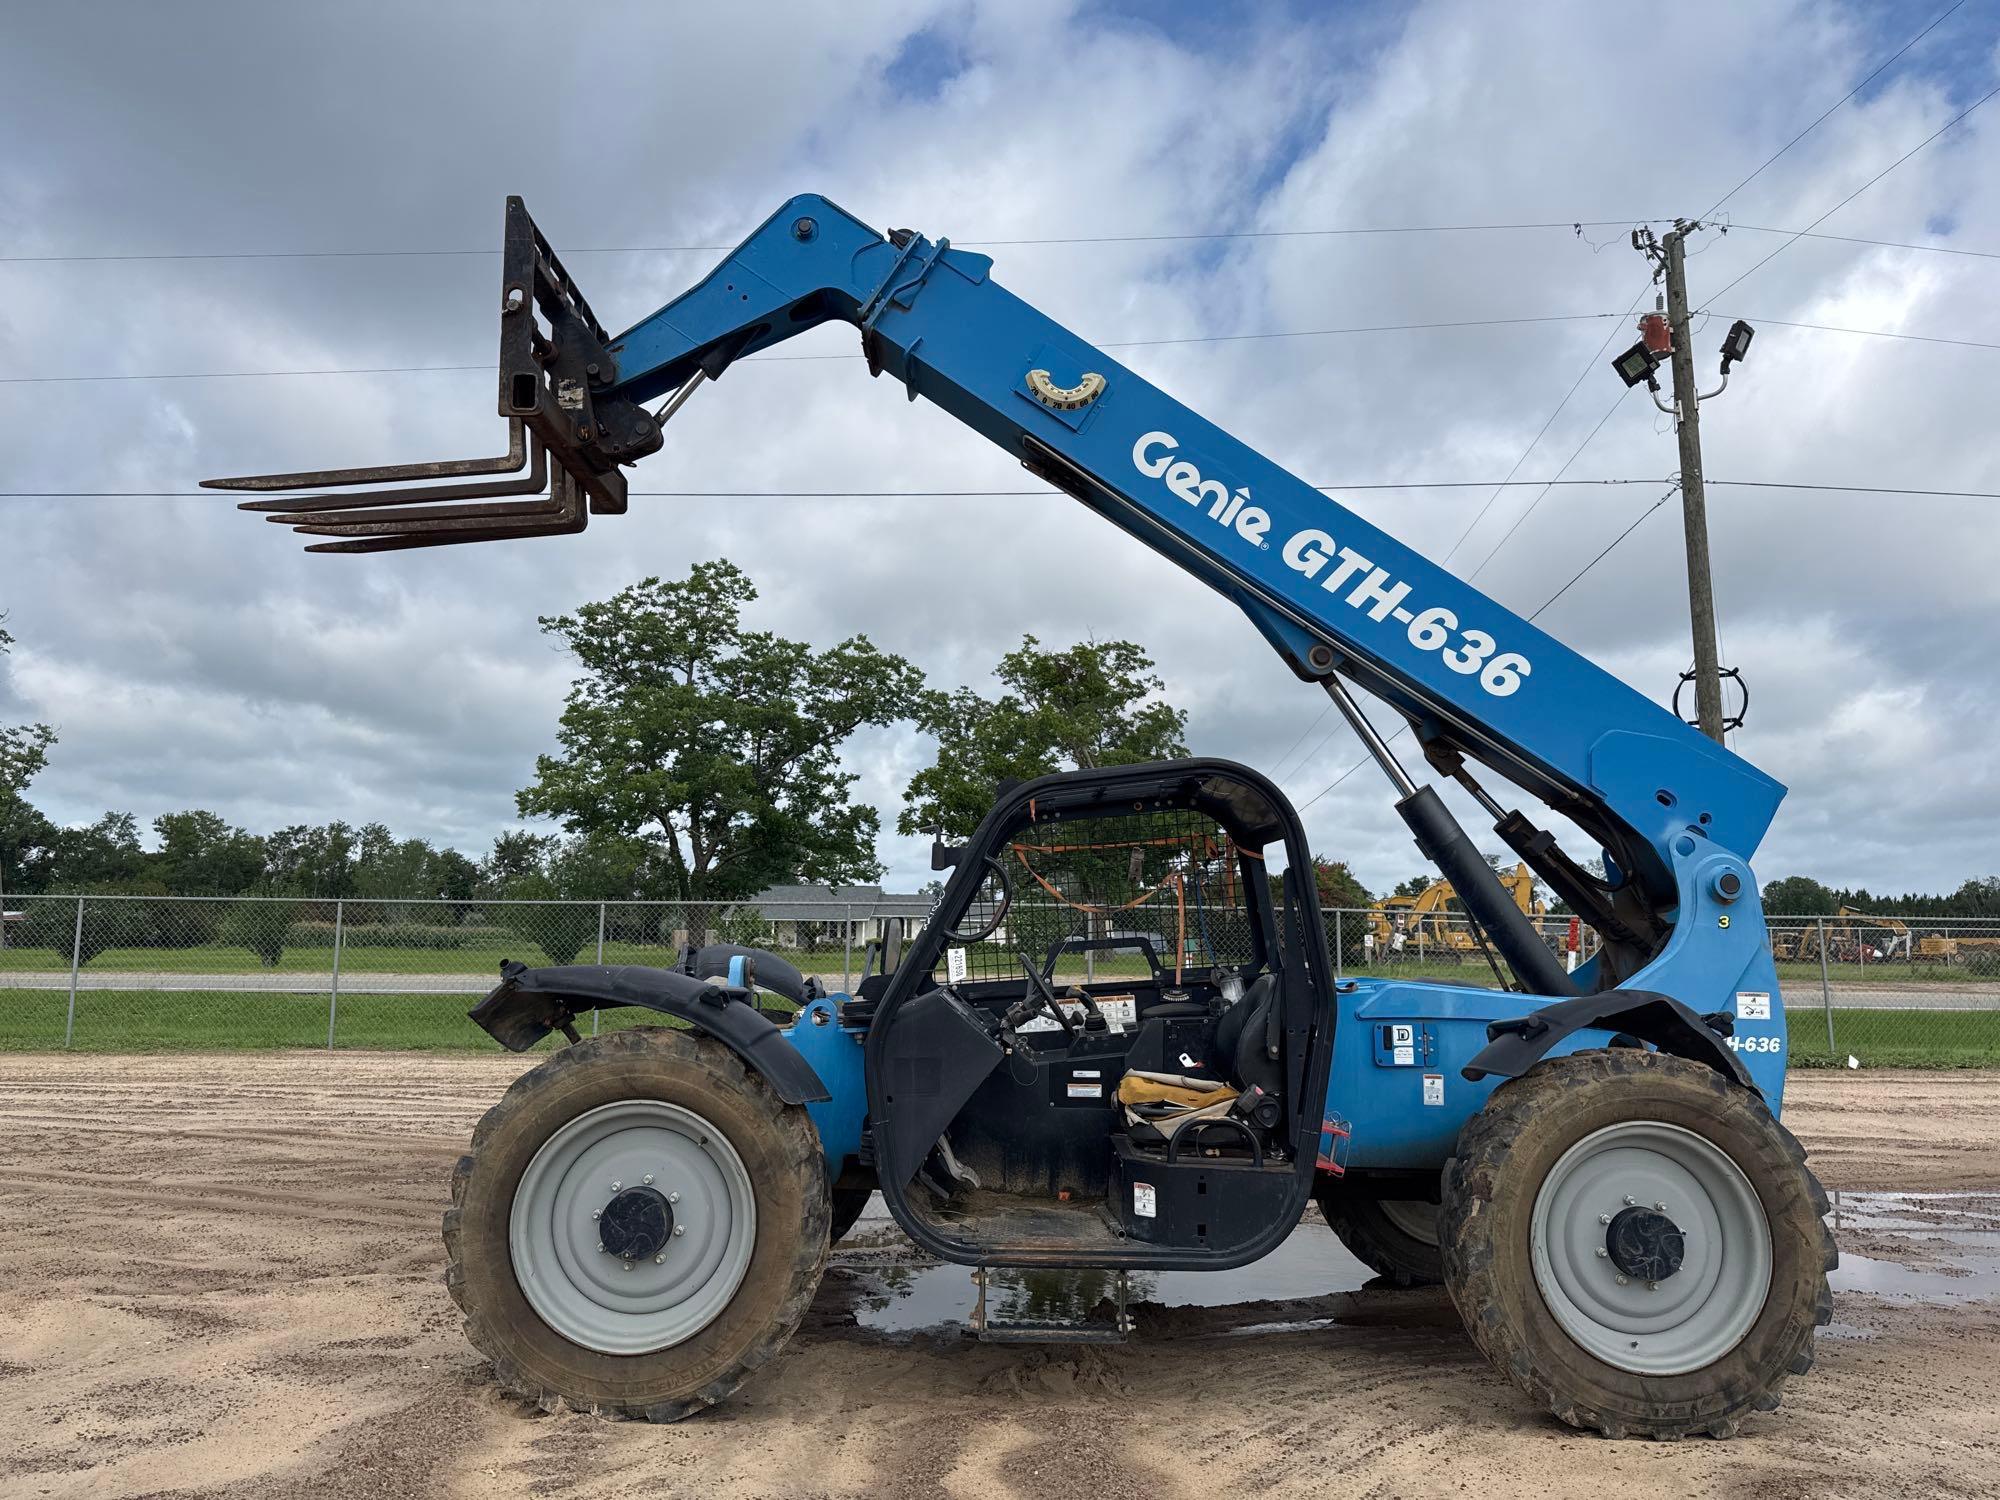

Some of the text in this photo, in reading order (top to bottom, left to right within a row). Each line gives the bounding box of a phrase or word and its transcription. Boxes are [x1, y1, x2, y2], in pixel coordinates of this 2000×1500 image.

[1053, 401, 1063, 410] 20
[1066, 402, 1076, 410] 40
[1079, 398, 1089, 408] 60
[1132, 431, 1532, 697] Genie GTH-636
[1718, 915, 1730, 929] 3
[1722, 1036, 1781, 1053] H-636
